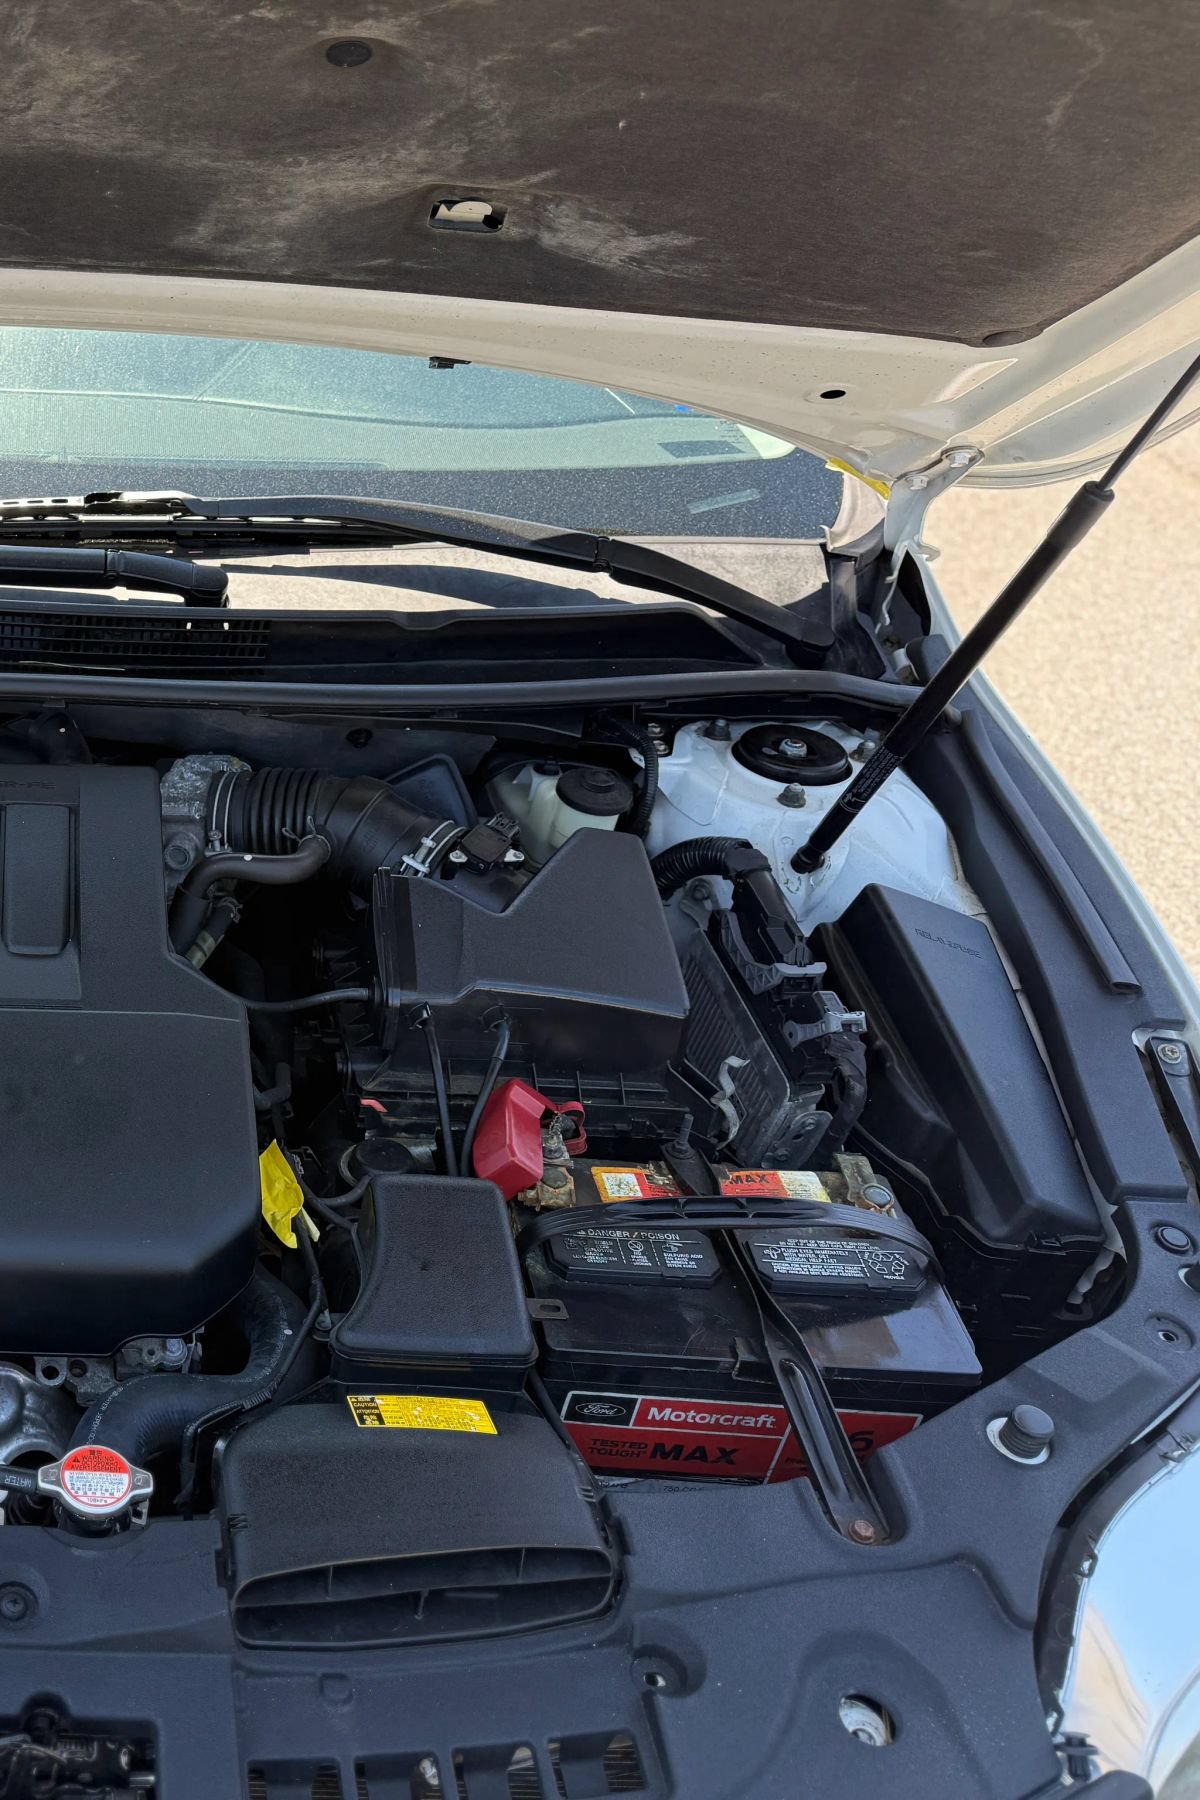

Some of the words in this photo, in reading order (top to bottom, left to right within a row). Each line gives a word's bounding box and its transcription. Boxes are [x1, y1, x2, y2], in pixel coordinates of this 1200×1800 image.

[587, 1229, 630, 1239] DANGER
[583, 1403, 617, 1416] Ford
[647, 1406, 776, 1430] Motorcraft
[591, 1438, 649, 1450] TESTED
[651, 1442, 739, 1466] MAX
[4, 1473, 32, 1488] WATER
